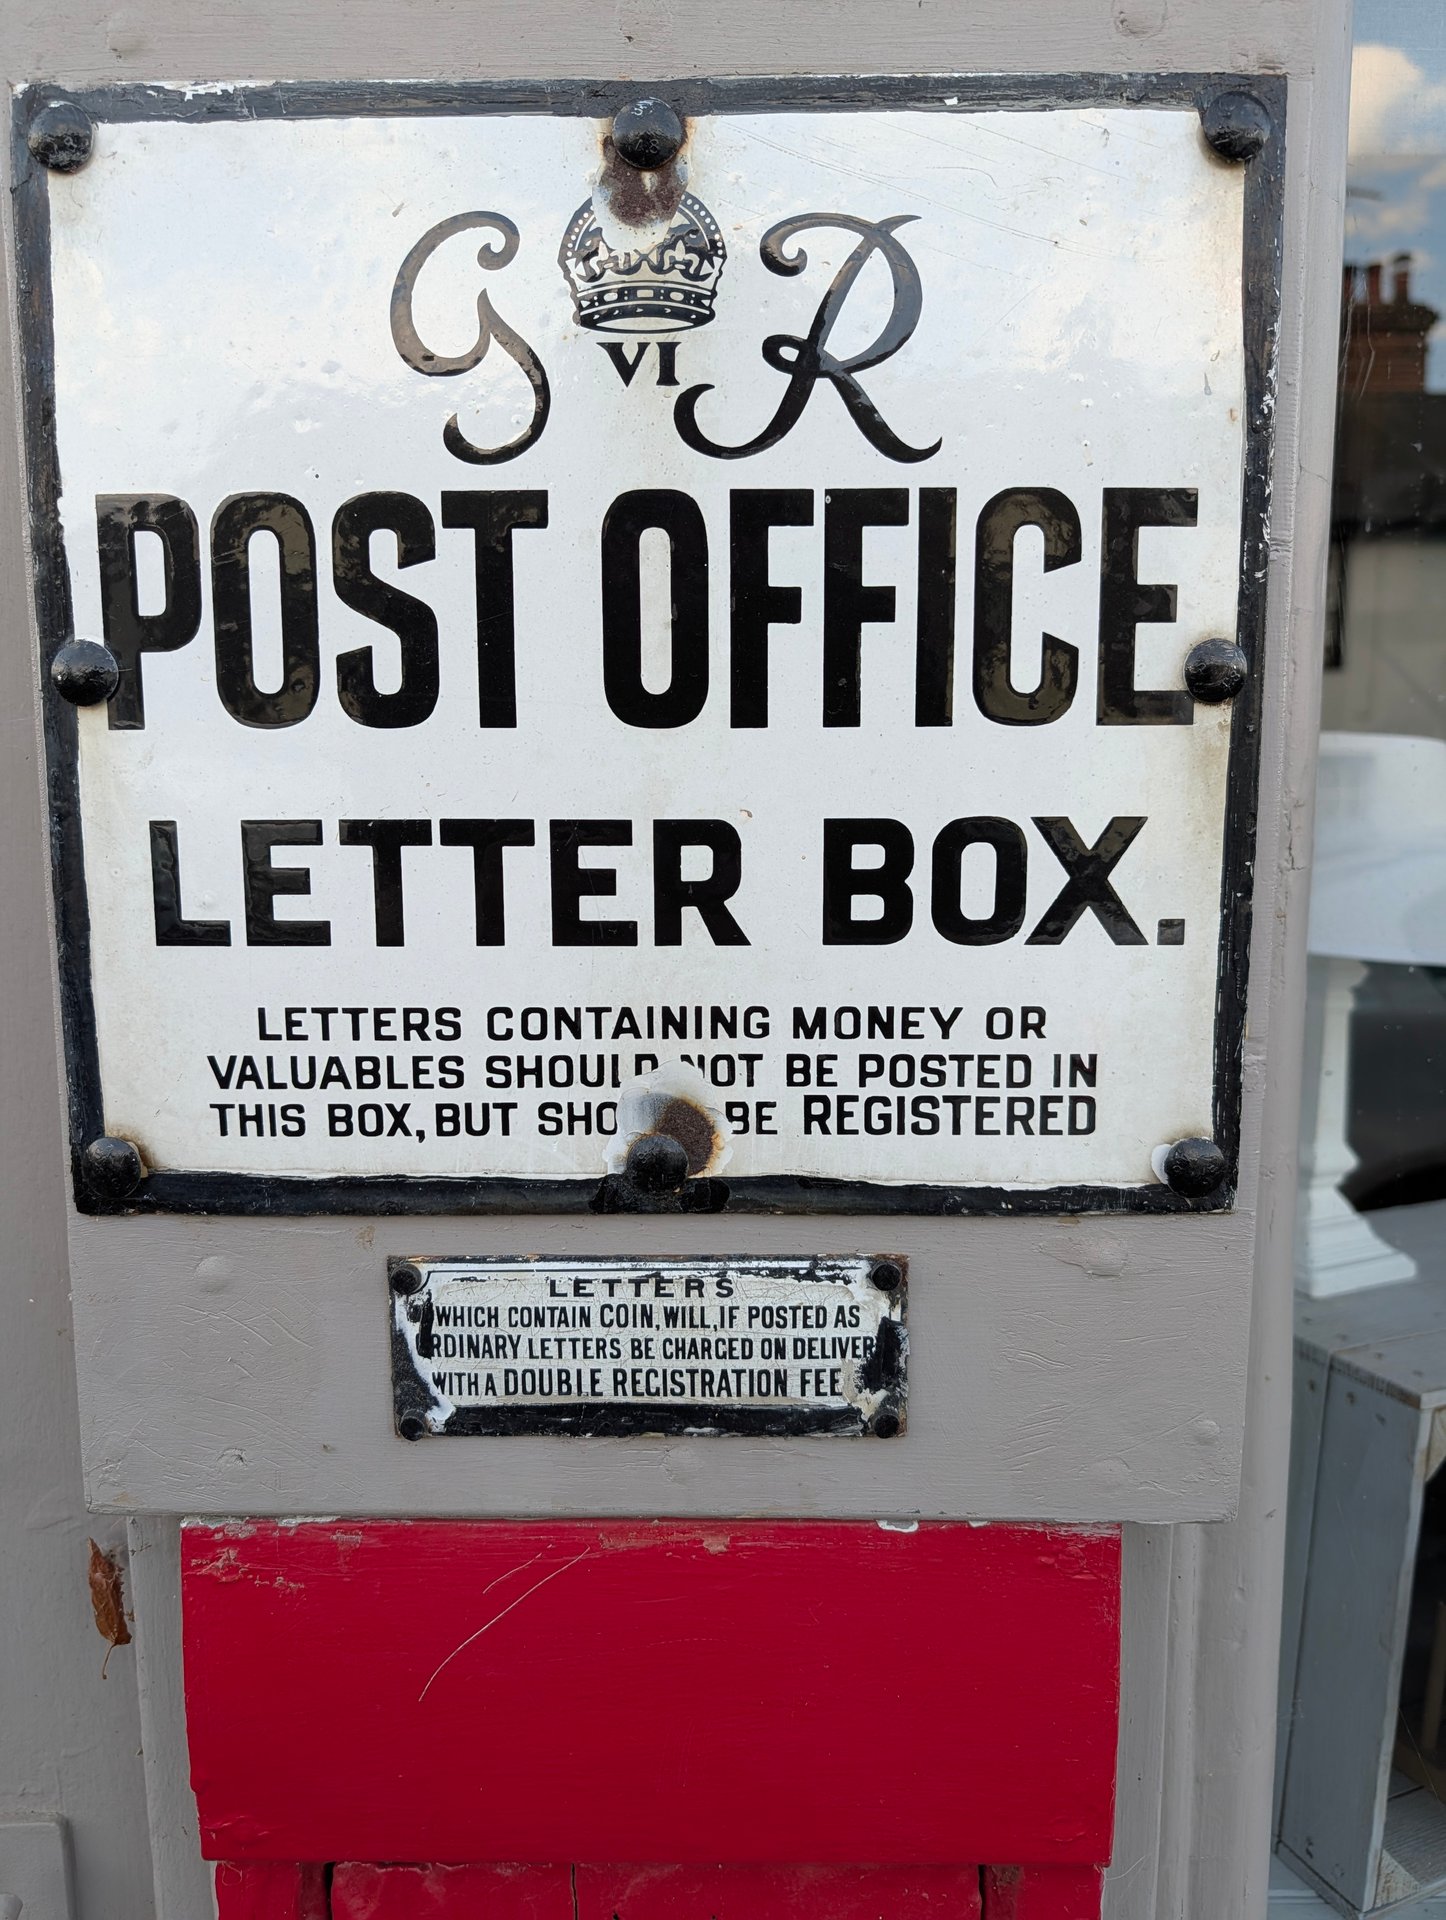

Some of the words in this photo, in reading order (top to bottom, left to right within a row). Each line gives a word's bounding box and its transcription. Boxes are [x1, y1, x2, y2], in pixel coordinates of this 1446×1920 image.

[596, 341, 680, 387] VI
[94, 489, 549, 730] POST
[600, 487, 1198, 728] OFFICE
[148, 818, 752, 948] LETTER
[822, 815, 1186, 947] BOX.
[257, 1006, 462, 1042] LETTERS
[486, 1005, 770, 1042] CONTAINING
[792, 1005, 964, 1040] MONEY
[985, 1005, 1047, 1040] OR
[206, 1055, 465, 1090] VALUABLES
[786, 1053, 838, 1088] BE
[858, 1053, 1032, 1089] POSTED
[1053, 1053, 1098, 1088] IN
[209, 1103, 306, 1138] THIS
[327, 1102, 426, 1144] BOX,
[435, 1102, 518, 1137] BUT
[724, 1101, 778, 1135] BE
[803, 1094, 1097, 1136] REGISTERED
[549, 1275, 734, 1299] LETTERS
[435, 1305, 499, 1329] WHICH
[508, 1305, 591, 1328] CONTAIN
[599, 1303, 660, 1332] COIN,
[663, 1305, 718, 1333] WILL,
[719, 1305, 740, 1329] IF
[747, 1305, 828, 1329] POSTED
[833, 1304, 861, 1329] AS
[527, 1337, 622, 1360] LETTERS
[630, 1337, 656, 1360] BE
[662, 1337, 754, 1360] CHARGED
[760, 1337, 787, 1360] ON
[792, 1335, 877, 1360] DELIVER
[431, 1371, 479, 1397] WITH
[484, 1372, 498, 1397] A
[503, 1368, 604, 1397] DOUBLE
[612, 1368, 788, 1398] REGISTRATION
[800, 1367, 843, 1398] FEE
